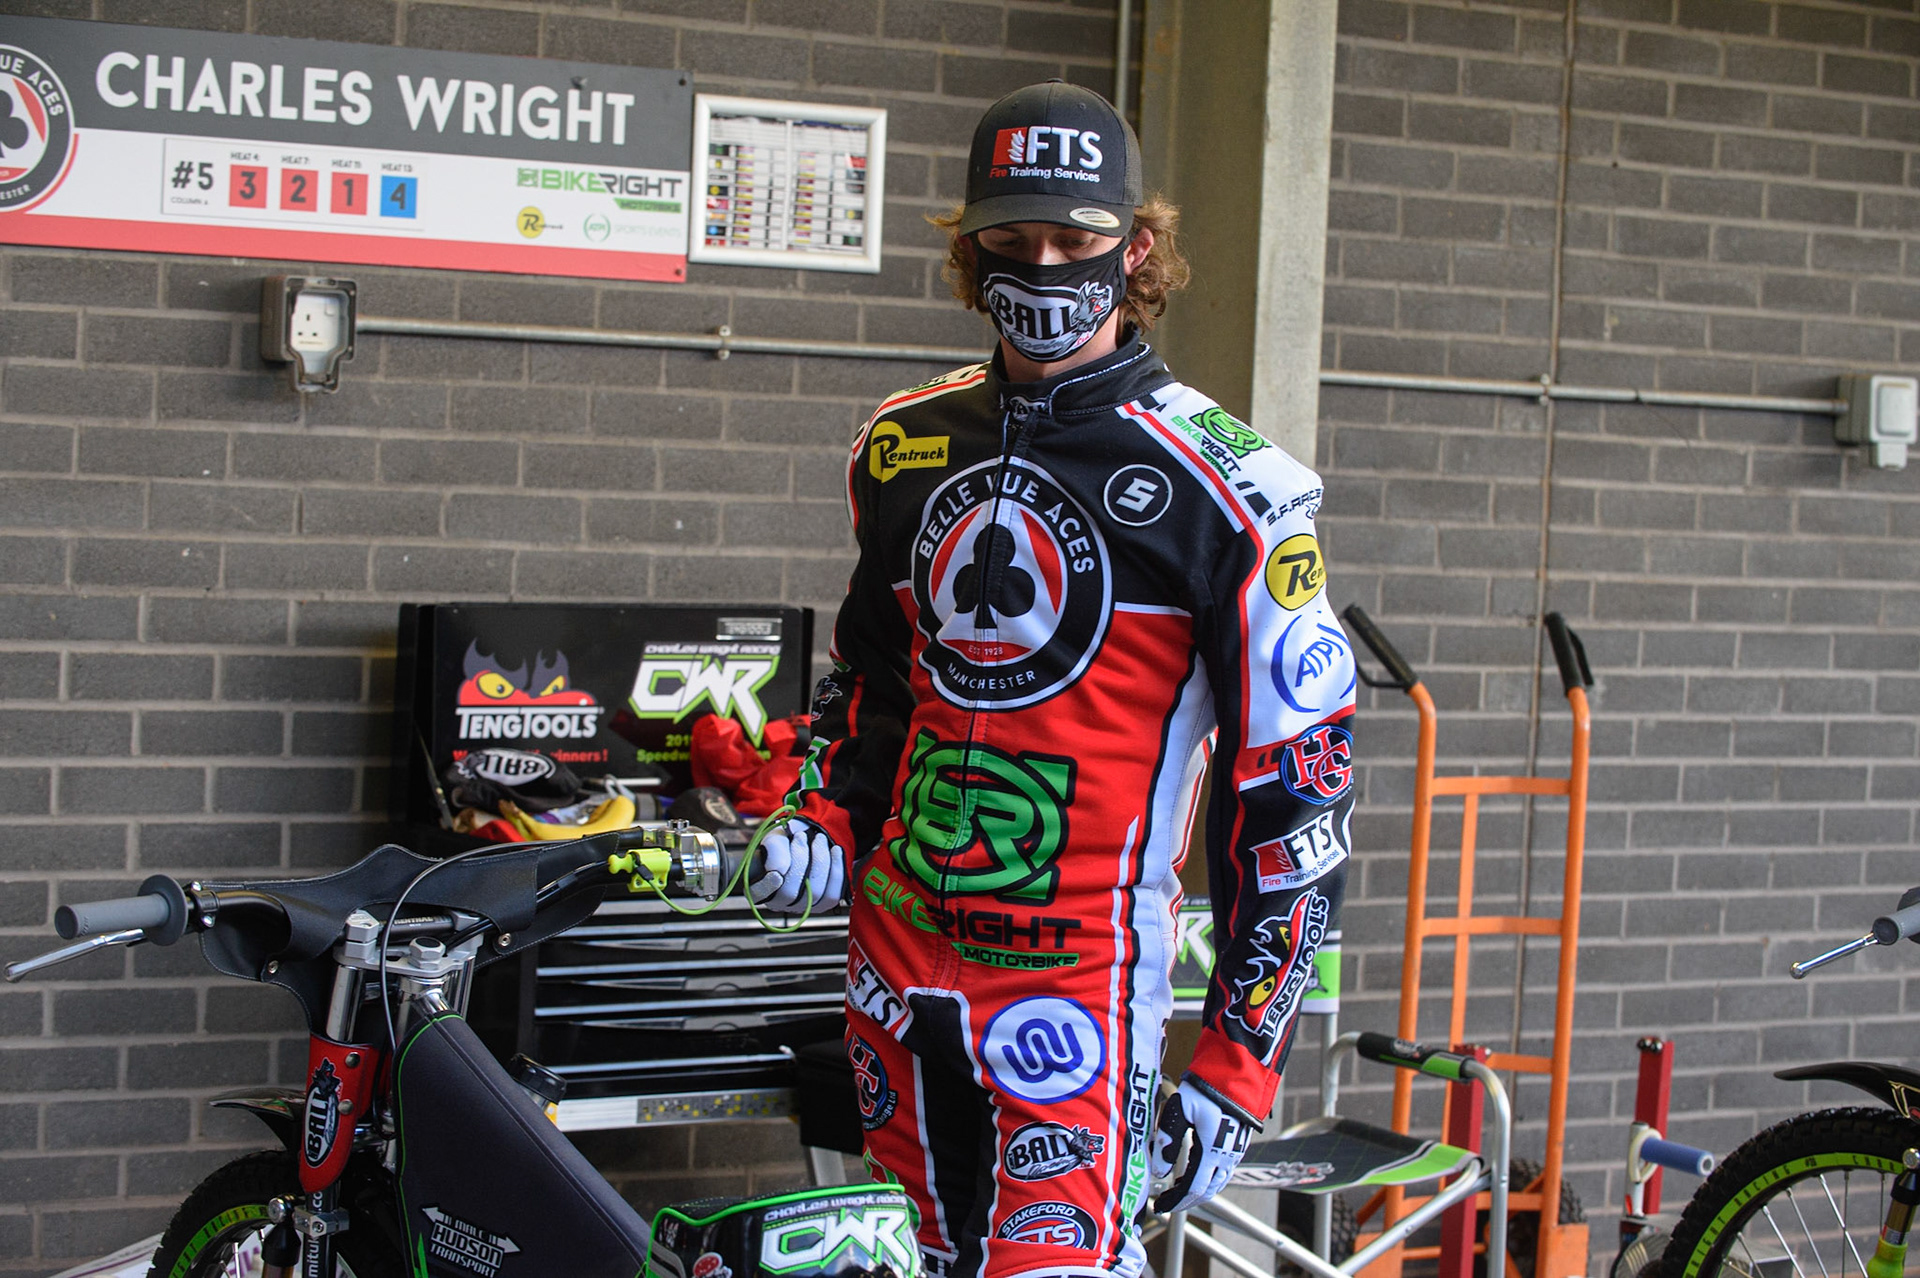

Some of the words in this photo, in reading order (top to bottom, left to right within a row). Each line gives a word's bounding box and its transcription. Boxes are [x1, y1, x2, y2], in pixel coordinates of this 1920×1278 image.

[0, 55, 25, 74] UE
[28, 70, 64, 117] ACES
[95, 51, 373, 125] CHARLES
[397, 74, 635, 146] WRIGHT
[1026, 126, 1103, 170] FTS
[171, 160, 213, 191] #5
[239, 171, 257, 200] 3
[290, 174, 307, 204] 2
[342, 178, 354, 207] 1
[541, 168, 683, 198] BIKERIGHT
[1009, 167, 1052, 179] Training
[1054, 168, 1100, 183] Services
[390, 182, 407, 211] 4
[996, 291, 1078, 339] BALL
[872, 434, 945, 470] Rentruck
[1170, 415, 1242, 473] BIKERIGHT
[919, 481, 975, 560] BELLE
[1044, 502, 1096, 574] ACES
[983, 646, 1003, 656] 1928
[947, 662, 1036, 690] MANCHESTER
[630, 658, 778, 743] CWR
[455, 706, 602, 739] TENGTOOLS
[1283, 815, 1332, 870] FTS
[1262, 877, 1281, 887] Fire
[1284, 867, 1319, 884] Training
[1317, 849, 1340, 870] Services
[862, 867, 1082, 949] BIKERIGHT
[963, 946, 1078, 969] MOTORBIKE
[856, 961, 903, 1027] FTS
[1010, 1134, 1073, 1170] BALL
[1001, 1204, 1077, 1236] STAKEFORD
[432, 1224, 502, 1267] HUDSON
[760, 1208, 912, 1275] CWR
[430, 1242, 497, 1278] TRANSPORT
